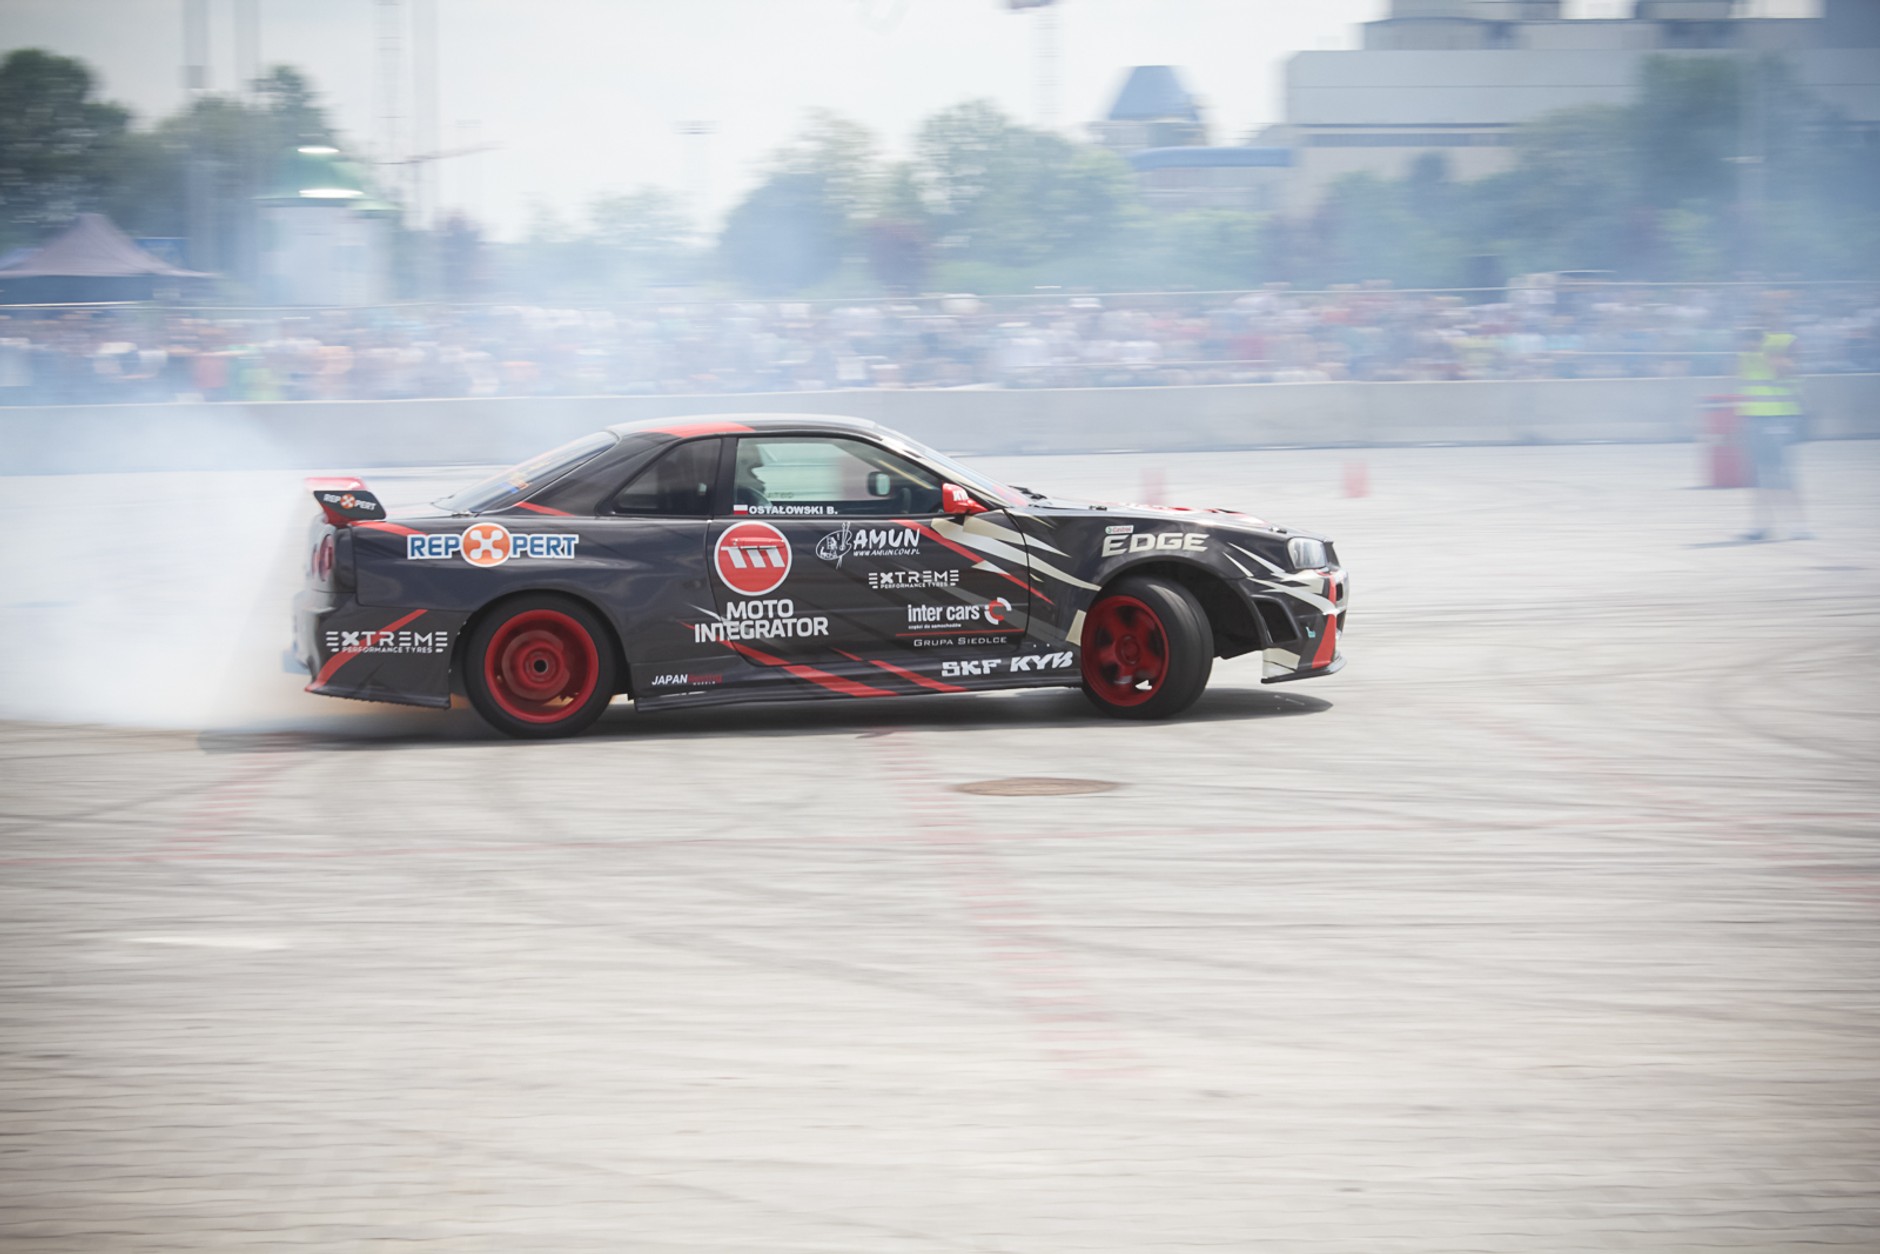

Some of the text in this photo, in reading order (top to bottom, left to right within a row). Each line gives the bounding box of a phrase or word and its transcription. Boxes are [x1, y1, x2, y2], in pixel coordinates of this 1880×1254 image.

[749, 505, 839, 515] OSTAŁOWSKI B.
[853, 527, 920, 550] AMUN
[1101, 532, 1210, 557] EDGE
[868, 569, 959, 589] EXTREME
[726, 599, 794, 620] MOTO
[907, 604, 980, 622] inter cars
[694, 616, 829, 643] INTEGRATOR
[326, 631, 448, 652] EXTREME
[913, 637, 1007, 647] GRUPA SIEDLCE
[941, 651, 1073, 677] SKF KYB
[651, 674, 688, 685] JAPAN
